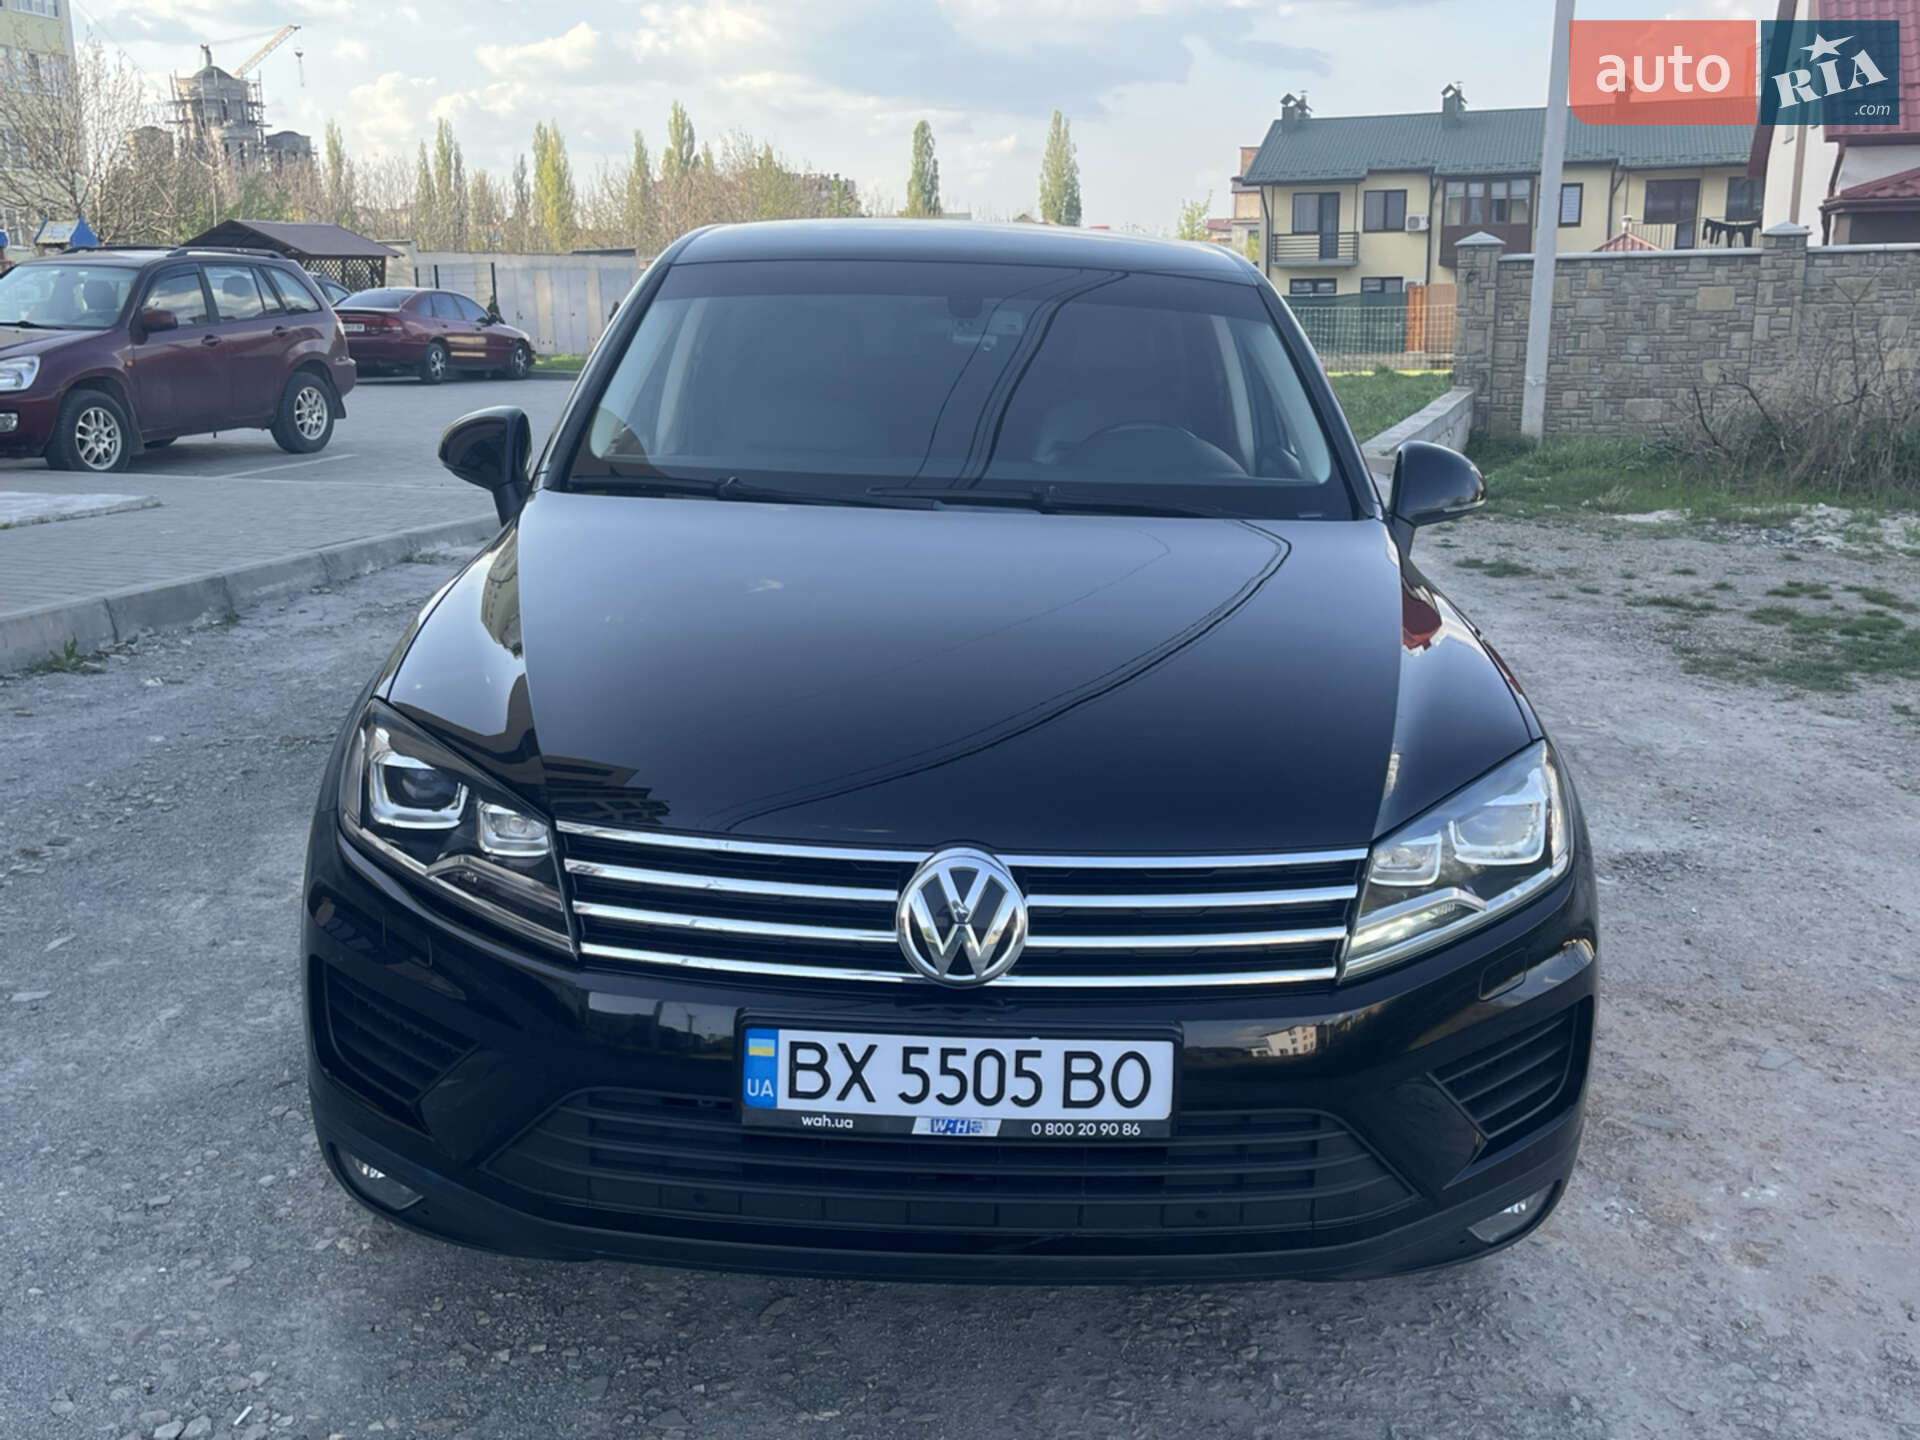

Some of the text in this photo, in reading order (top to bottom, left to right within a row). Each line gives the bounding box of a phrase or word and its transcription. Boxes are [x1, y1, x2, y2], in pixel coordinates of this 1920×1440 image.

[787, 1040, 1152, 1109] BX 5505 BO
[746, 1078, 775, 1098] UA
[801, 1114, 854, 1129] wah.ua
[1031, 1122, 1141, 1136] 0 800 20 90 86
